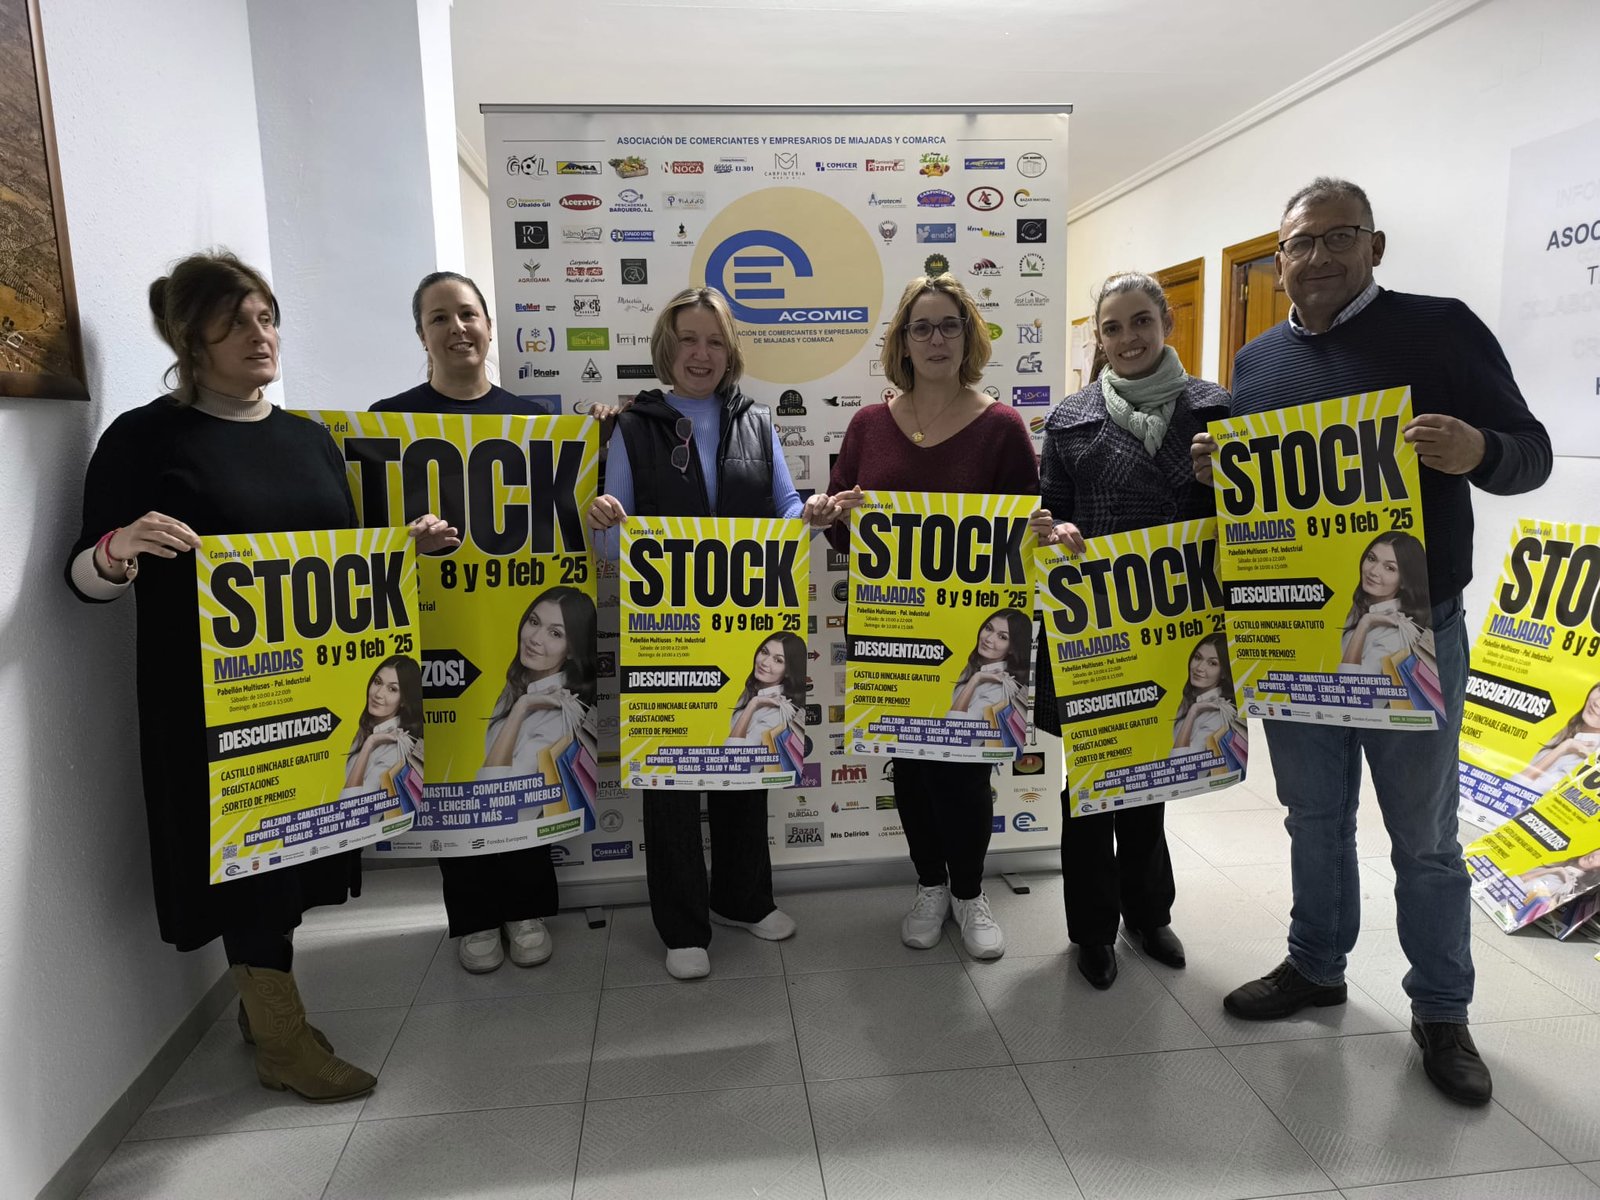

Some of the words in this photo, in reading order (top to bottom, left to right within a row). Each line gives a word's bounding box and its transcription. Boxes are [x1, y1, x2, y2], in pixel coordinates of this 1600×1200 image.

[617, 135, 672, 145] ASOCIACIÓN
[902, 136, 946, 144] COMARCA
[674, 165, 702, 173] NOCA
[562, 198, 600, 206] Aceravis
[779, 310, 863, 321] ACOMIC
[1216, 430, 1239, 441] Campaña
[1240, 428, 1249, 436] del
[1220, 416, 1408, 516] STOCK
[344, 437, 587, 556] TOCK
[1226, 519, 1295, 542] MIAJADAS
[1306, 516, 1318, 537] 8
[1321, 517, 1332, 537] y
[1335, 513, 1347, 534] 9
[1350, 510, 1379, 533] feb
[210, 549, 241, 560] Campaña
[242, 548, 253, 557] del
[858, 512, 1029, 584] STOCK
[441, 560, 455, 589] 8
[464, 563, 478, 592] y
[486, 559, 501, 587] 9
[508, 558, 544, 586] feb
[630, 538, 799, 607] STOCK
[856, 584, 925, 603] MIAJADAS
[936, 588, 946, 605] 8
[950, 591, 958, 607] y
[962, 589, 972, 606] 9
[976, 590, 999, 607] feb
[1048, 539, 1224, 634] STOCK
[1230, 584, 1326, 605] ¡DESCUENTAZOS!
[211, 551, 410, 648] STOCK
[629, 613, 700, 631] MIAJADAS
[712, 614, 721, 631] 8
[725, 616, 733, 632] y
[738, 614, 746, 631] 9
[751, 614, 773, 631] feb
[1233, 621, 1259, 629] CASTILLO
[1261, 621, 1291, 629] HINCHABLE
[1293, 621, 1324, 629] GRATUITO
[1058, 632, 1130, 660] MIAJADAS
[1140, 627, 1151, 646] 8
[1153, 627, 1164, 645] y
[1166, 623, 1177, 641] 9
[1179, 617, 1204, 639] feb
[1235, 634, 1280, 643] DEGUSTACIONES
[1489, 614, 1554, 646] MIAJADAS
[1562, 630, 1575, 651] 8
[1573, 636, 1587, 656] y
[1587, 636, 1600, 657] 9
[214, 648, 303, 680] MIAJADAS
[316, 645, 327, 666] 8
[332, 645, 342, 666] y
[346, 641, 356, 662] 9
[360, 637, 385, 660] feb
[854, 641, 944, 661] ¡DESCUENTAZOS!
[1236, 649, 1260, 659] ¡SORTEO
[1261, 649, 1267, 657] DE
[1269, 649, 1296, 658] PREMIOS!
[217, 685, 242, 696] Pabellón
[243, 681, 270, 692] Multiusos
[285, 675, 311, 685] Industrial
[629, 672, 721, 687] ¡DESCUENTAZOS!
[629, 702, 655, 710] CASTILLO
[1066, 686, 1158, 717] ¡DESCUENTAZOS!
[1466, 676, 1551, 718] DESCUENTAZOS!
[218, 713, 331, 753] ¡DESCUENTAZOS!
[629, 728, 652, 736] ¡SORTEO
[1500, 722, 1528, 739] GRATUITO
[220, 765, 255, 781] CASTILLO
[256, 758, 293, 774] HINCHABLE
[295, 750, 329, 765] GRATUITO
[222, 776, 279, 797] DEGUSTACIONES
[473, 777, 543, 796] COMPLEMENTOS
[222, 798, 253, 815] ¡SORTEO
[254, 796, 262, 805] DE
[264, 788, 296, 803] PREMIOS!
[439, 797, 480, 812] LENCERÍA
[489, 794, 515, 808] MODA
[524, 787, 560, 804] MUEBLES
[442, 814, 470, 826] SALUD
[474, 813, 480, 824] Y
[482, 810, 502, 823] MÁS
[787, 834, 822, 843] ZAIRA
